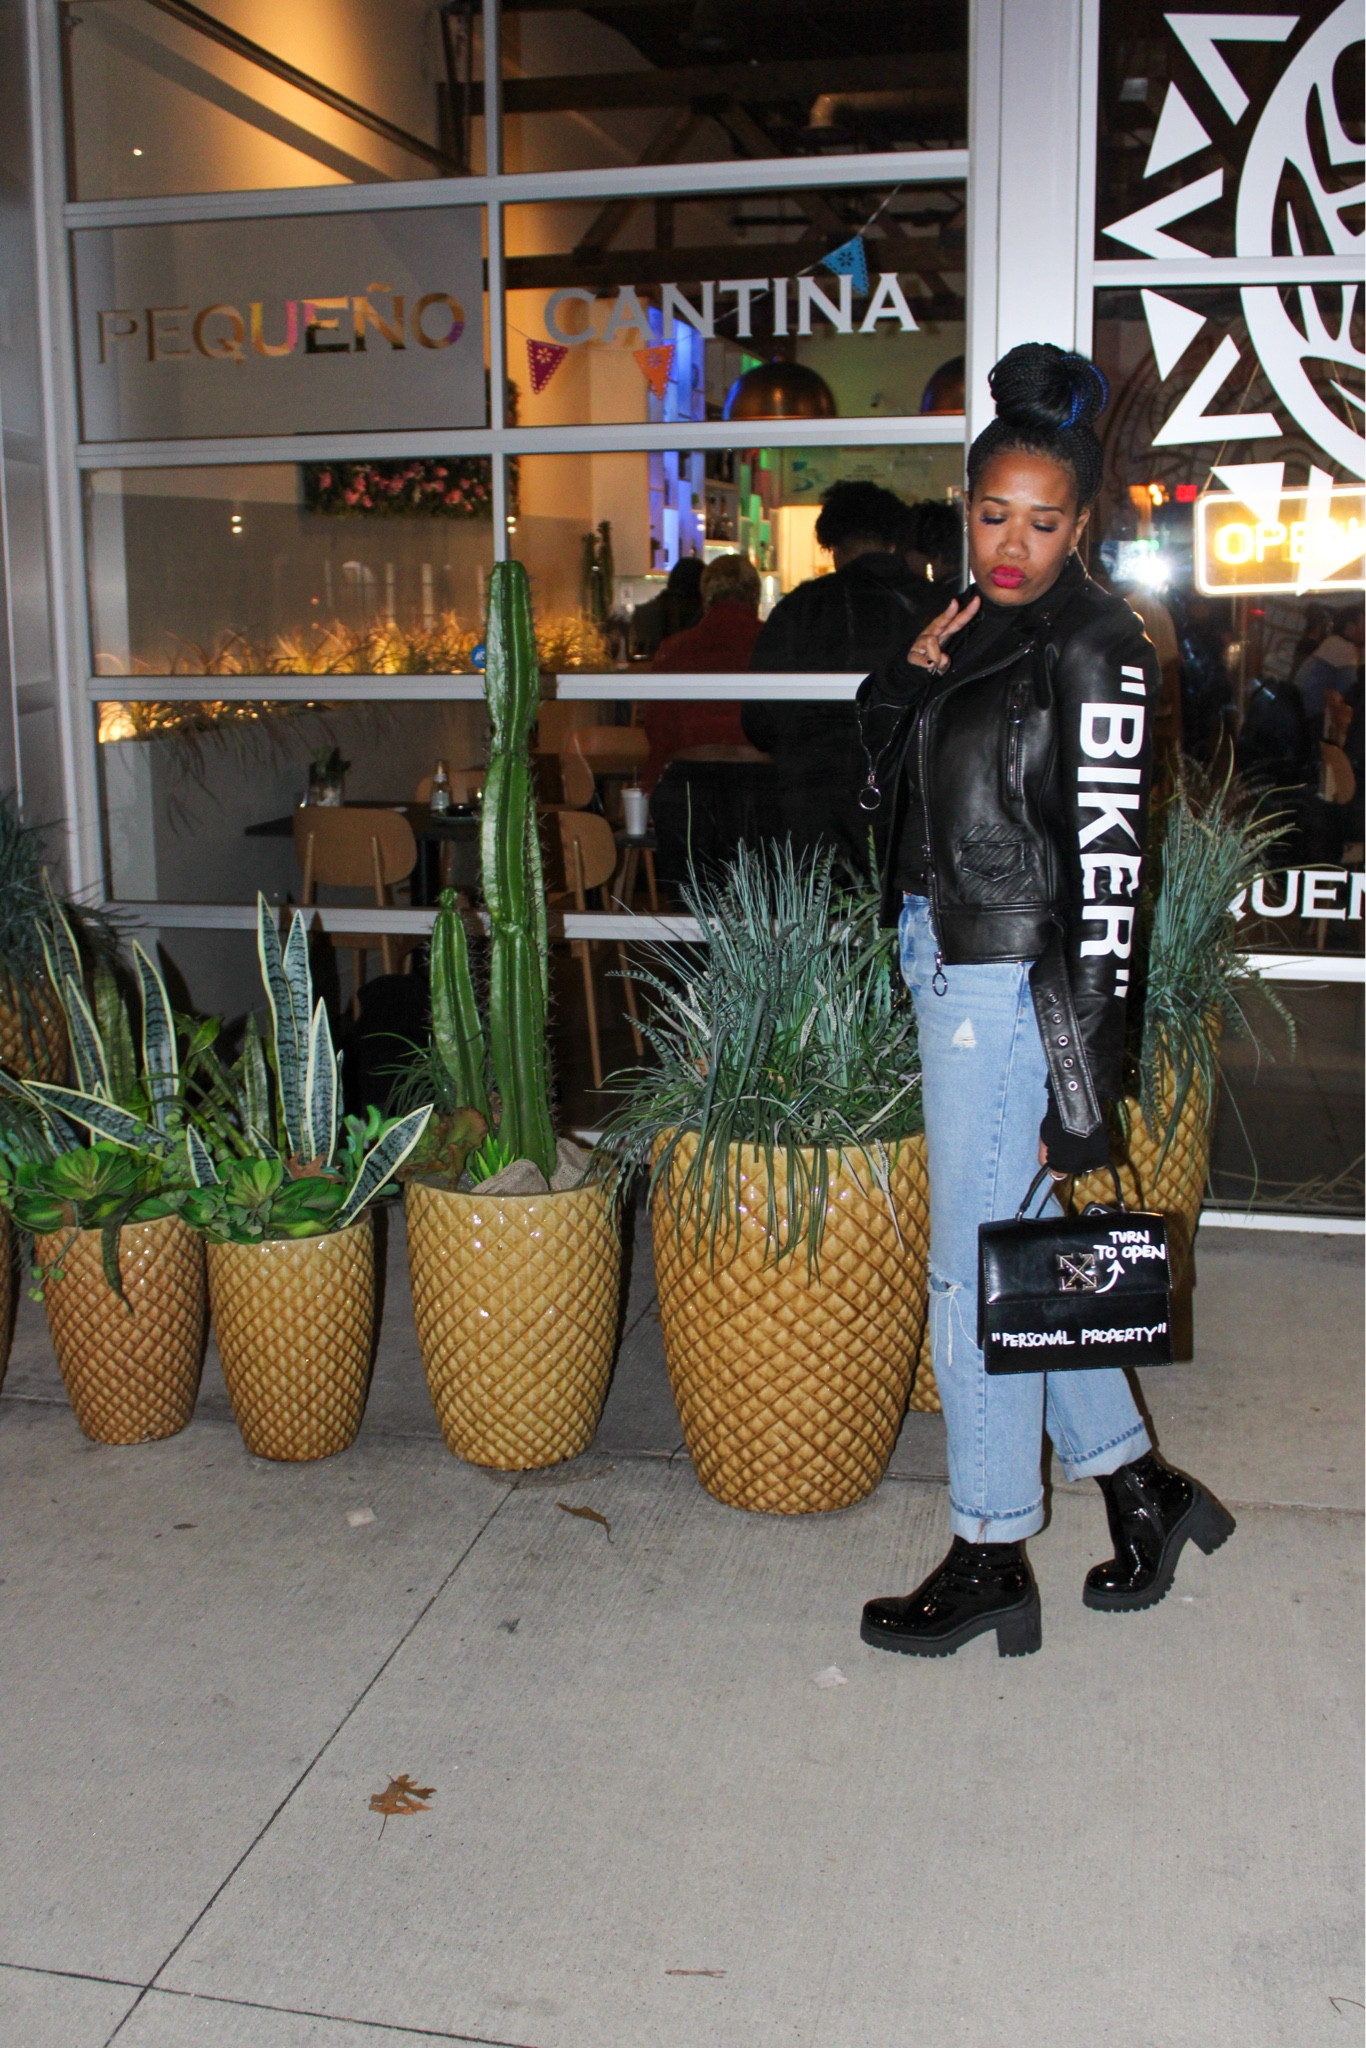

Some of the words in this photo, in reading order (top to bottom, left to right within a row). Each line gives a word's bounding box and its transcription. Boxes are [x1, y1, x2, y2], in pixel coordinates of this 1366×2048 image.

[96, 281, 466, 366] PEQUEÑO
[543, 272, 921, 345] CANTINA
[1077, 665, 1147, 999] "BIKER"
[1108, 1230, 1151, 1245] TURN
[1093, 1244, 1118, 1260] TO
[1121, 1243, 1167, 1264] OPEN
[991, 1329, 1076, 1349] "PERSONAL
[1081, 1322, 1167, 1346] PROPERTY"
